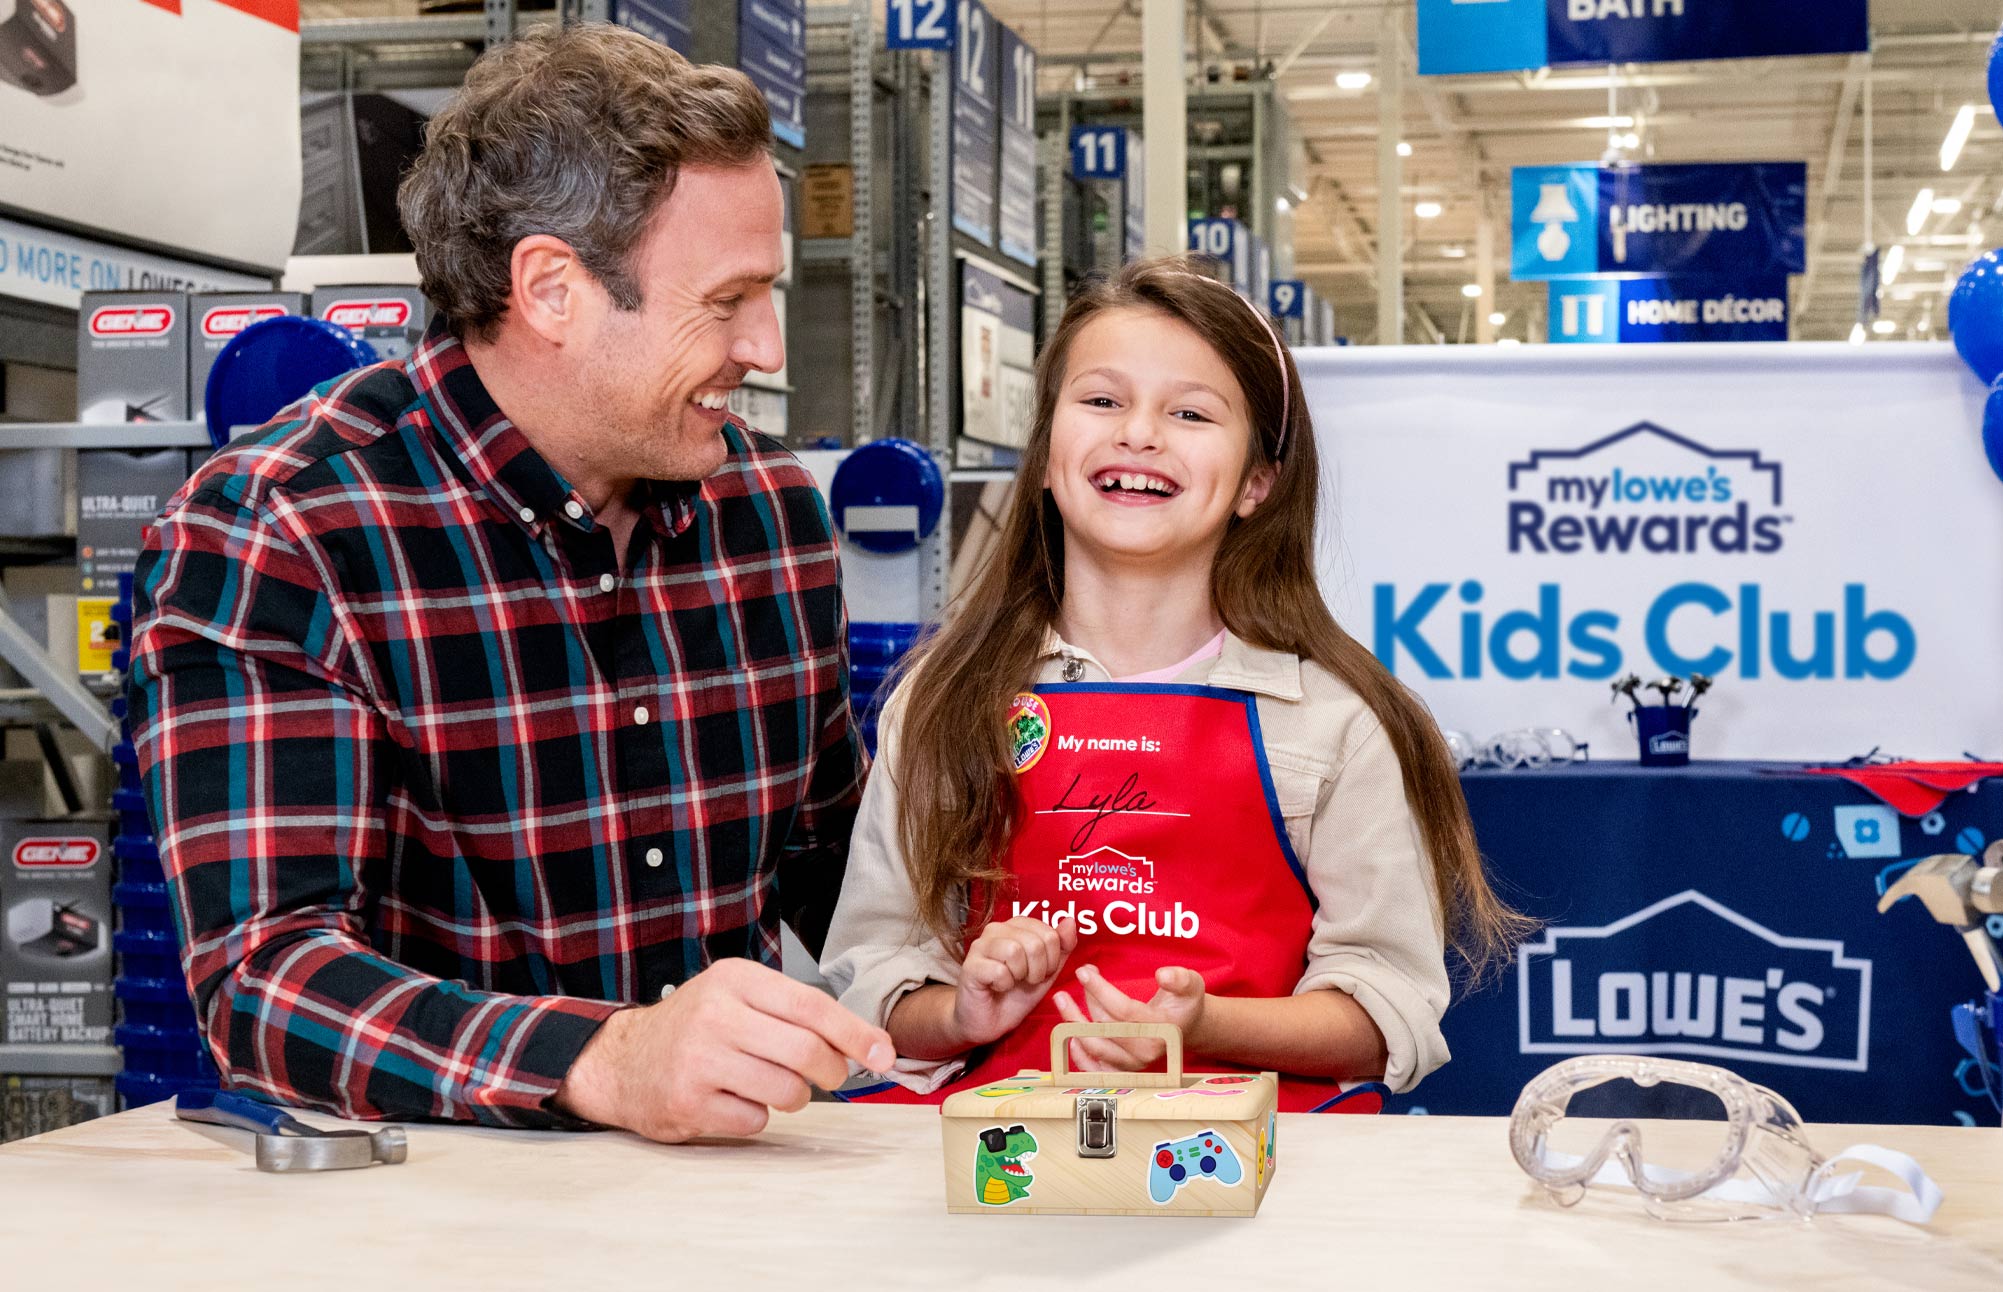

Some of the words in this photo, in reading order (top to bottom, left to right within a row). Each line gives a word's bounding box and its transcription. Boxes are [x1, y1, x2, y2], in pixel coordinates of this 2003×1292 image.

[891, 0, 946, 39] 12
[958, 1, 984, 94] 12
[1079, 132, 1116, 171] 11
[1610, 202, 1747, 233] LIGHTING
[1191, 222, 1229, 255] 10
[17, 242, 80, 289] MORE
[90, 259, 121, 289] ON
[1275, 284, 1296, 312] 9
[1627, 299, 1698, 325] HOME
[1702, 293, 1784, 324] DÉCOR
[1373, 580, 1623, 681] Kids
[1644, 582, 1917, 681] Club
[1012, 696, 1039, 712] OUSE
[1057, 735, 1085, 753] My
[1087, 738, 1138, 752] name
[1141, 735, 1161, 753] is:
[1052, 772, 1157, 852] Lyla
[20, 845, 92, 862] GENIE
[1072, 861, 1137, 877] mylowe's
[1103, 900, 1200, 939] Club
[1552, 958, 1825, 1052] LOWE'S
